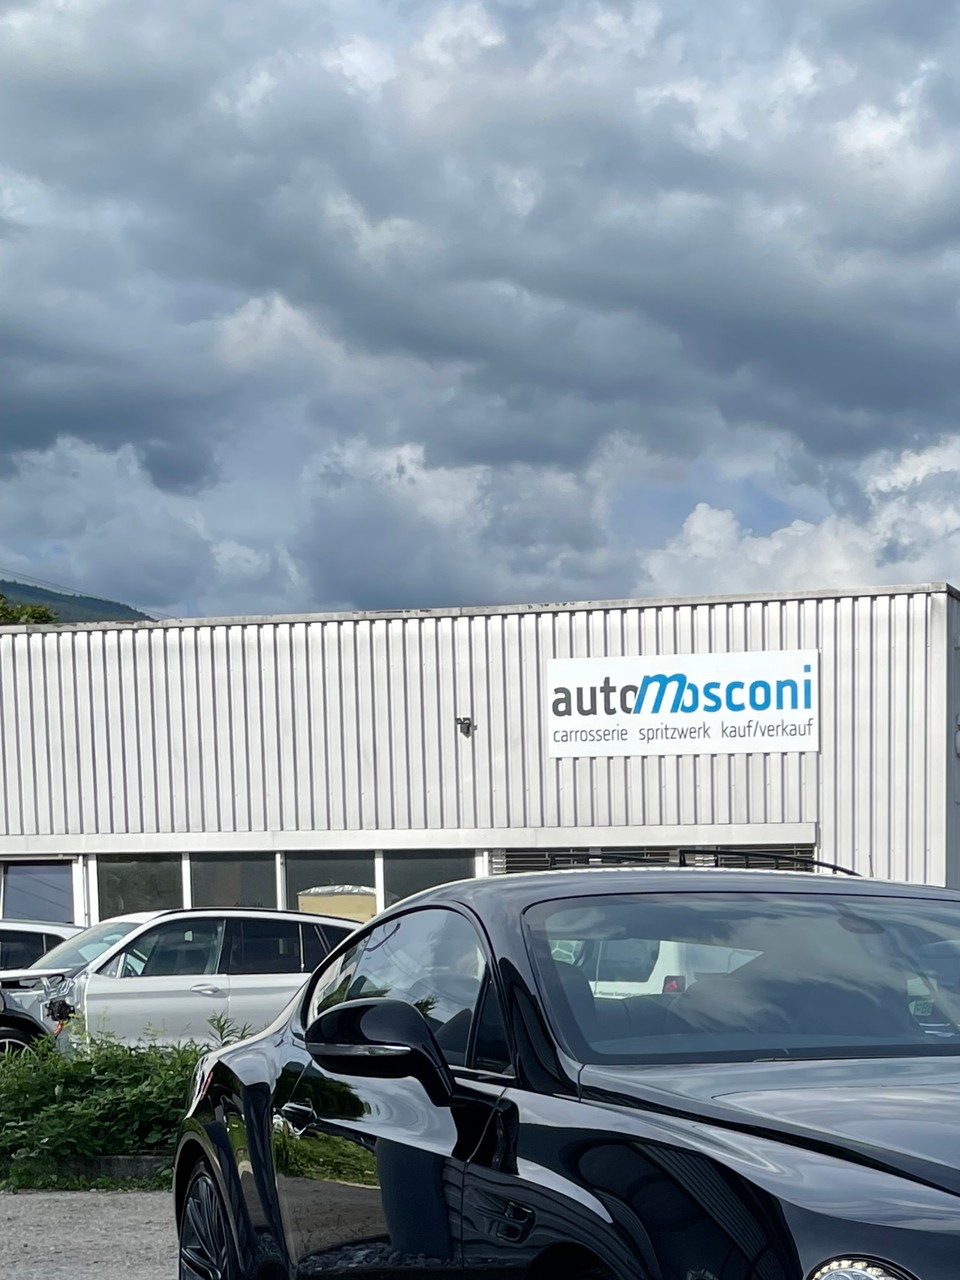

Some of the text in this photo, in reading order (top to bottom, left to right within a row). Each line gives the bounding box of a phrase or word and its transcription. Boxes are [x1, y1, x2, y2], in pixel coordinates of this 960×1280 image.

[553, 717, 814, 744] carrosserie spritzwerk kauf/verkauf
